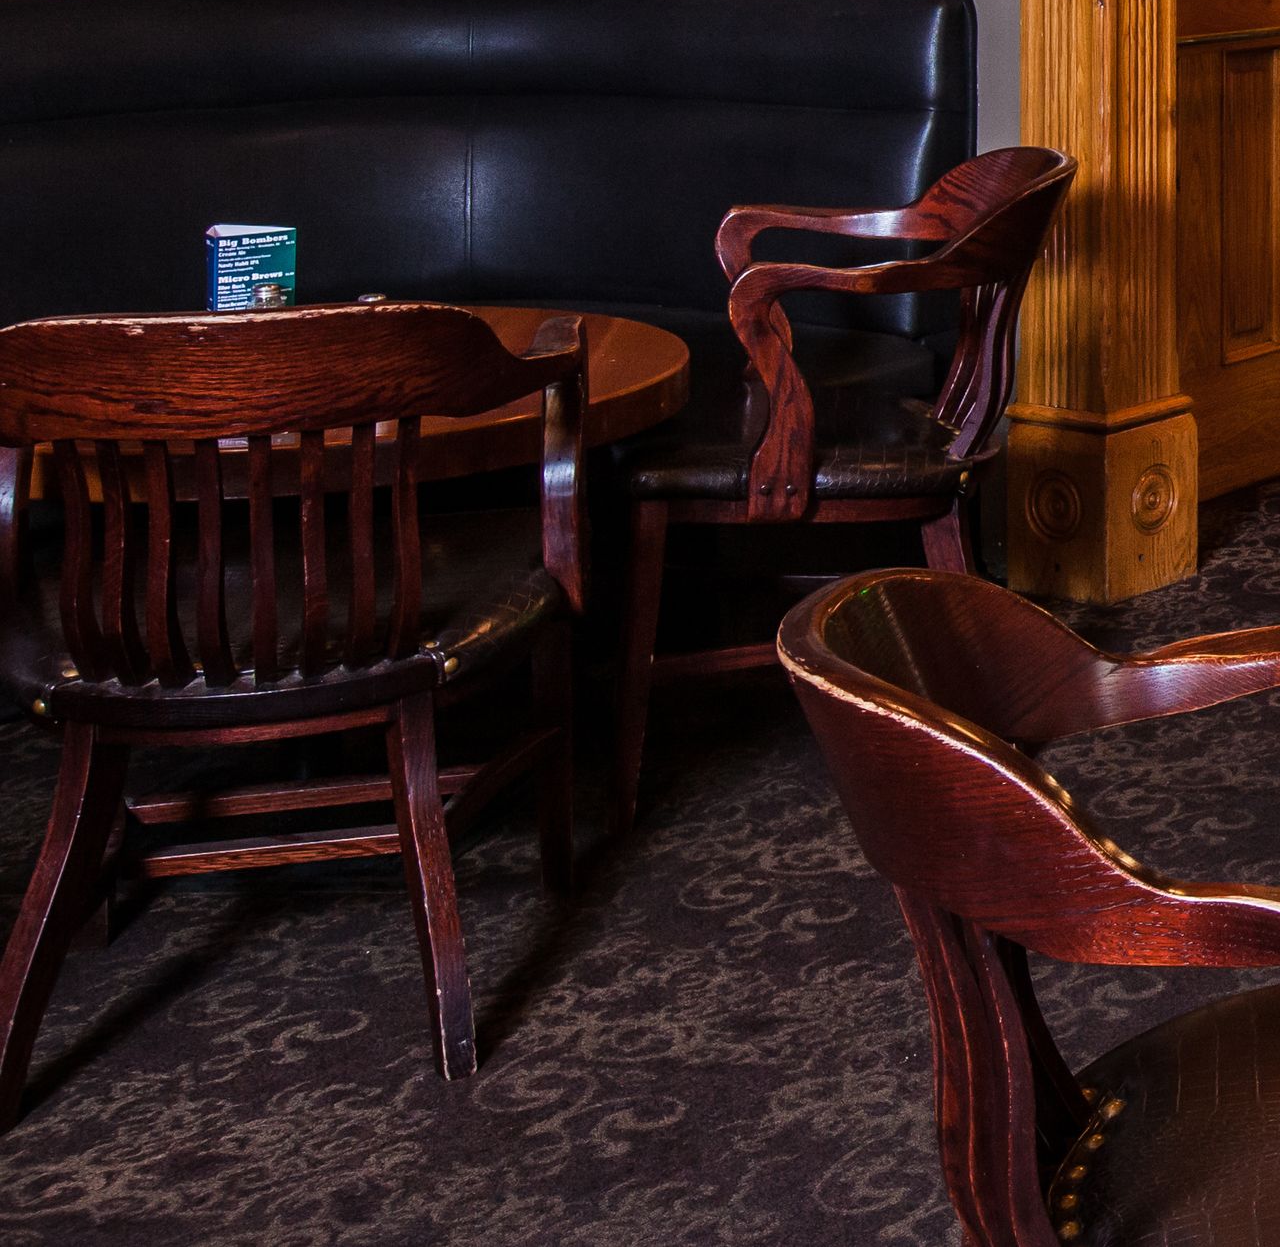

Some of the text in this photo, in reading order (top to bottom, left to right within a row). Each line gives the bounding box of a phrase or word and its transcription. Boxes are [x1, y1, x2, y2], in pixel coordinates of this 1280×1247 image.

[242, 235, 288, 245] Bombers
[218, 276, 250, 284] Micro
[252, 272, 283, 280] Brews
